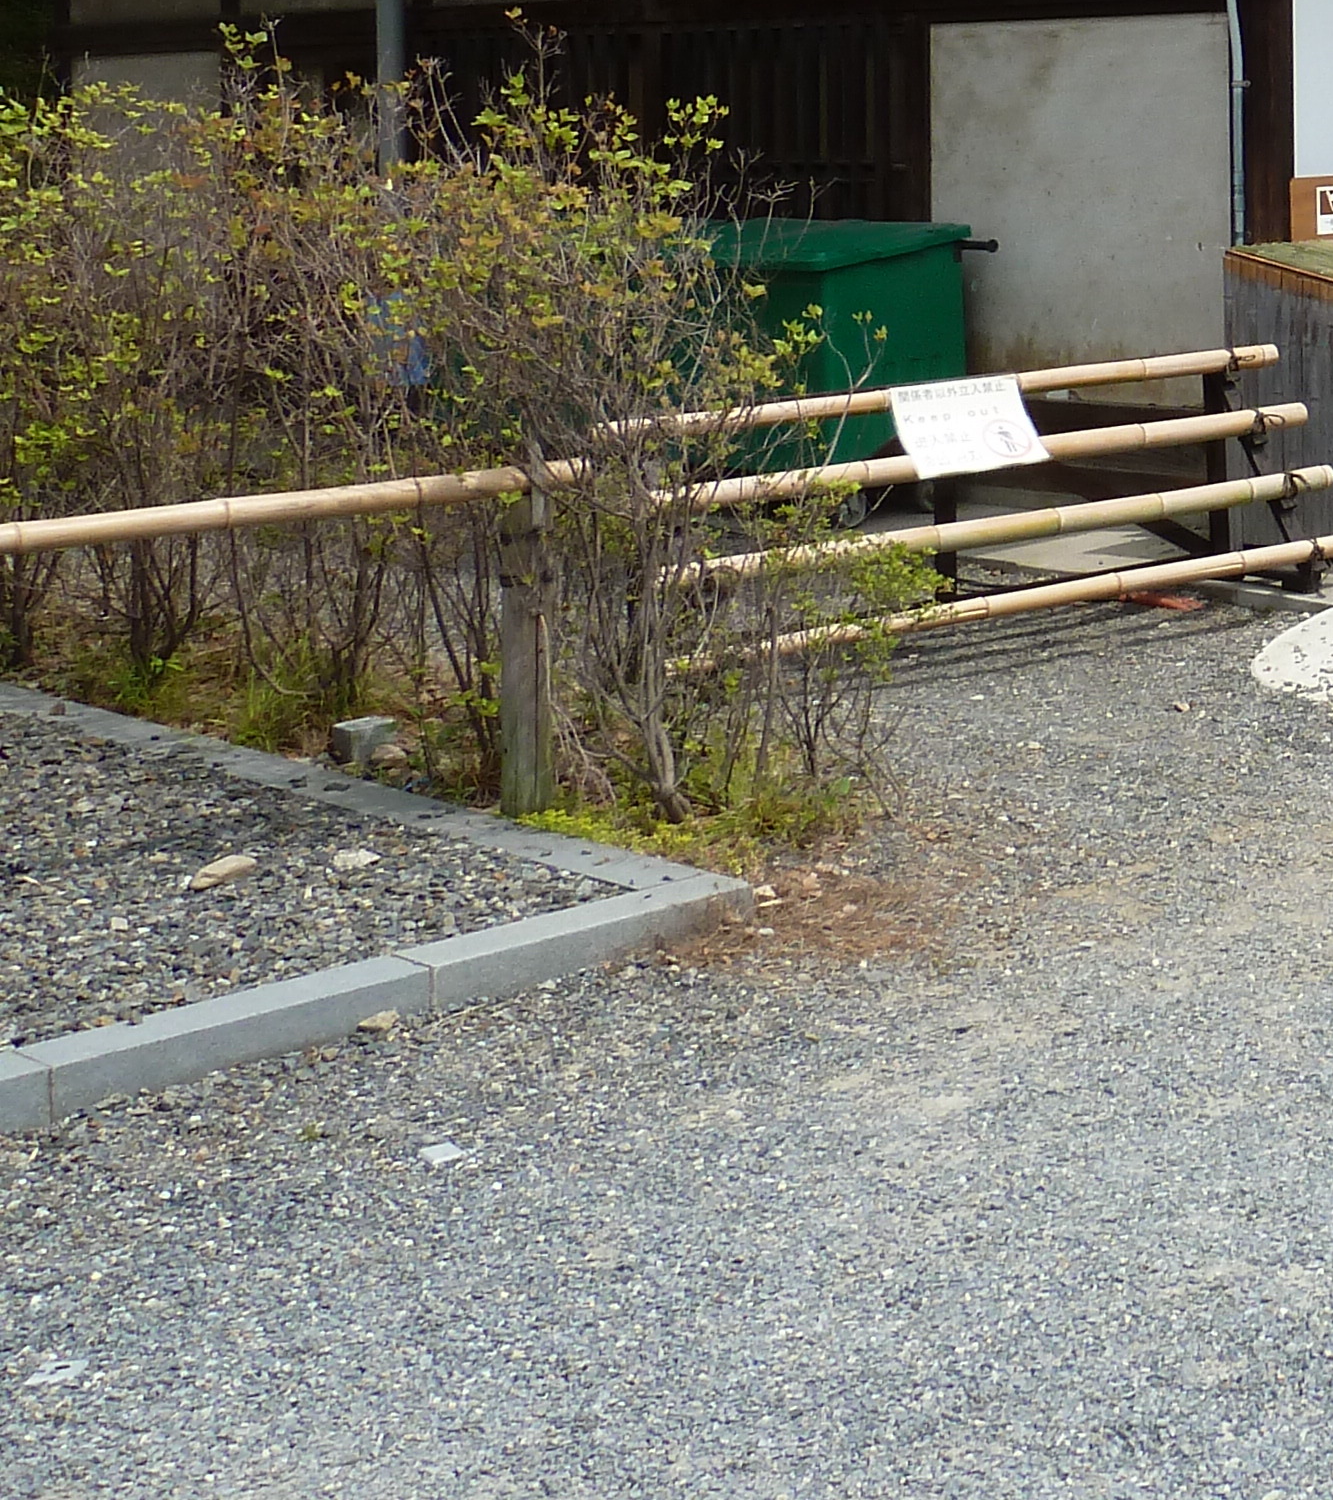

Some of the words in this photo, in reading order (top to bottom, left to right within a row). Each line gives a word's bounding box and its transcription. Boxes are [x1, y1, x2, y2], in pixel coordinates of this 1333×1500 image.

[898, 380, 1007, 403] 関係者以外立入禁止
[903, 413, 951, 425] Keep
[967, 405, 1000, 418] out
